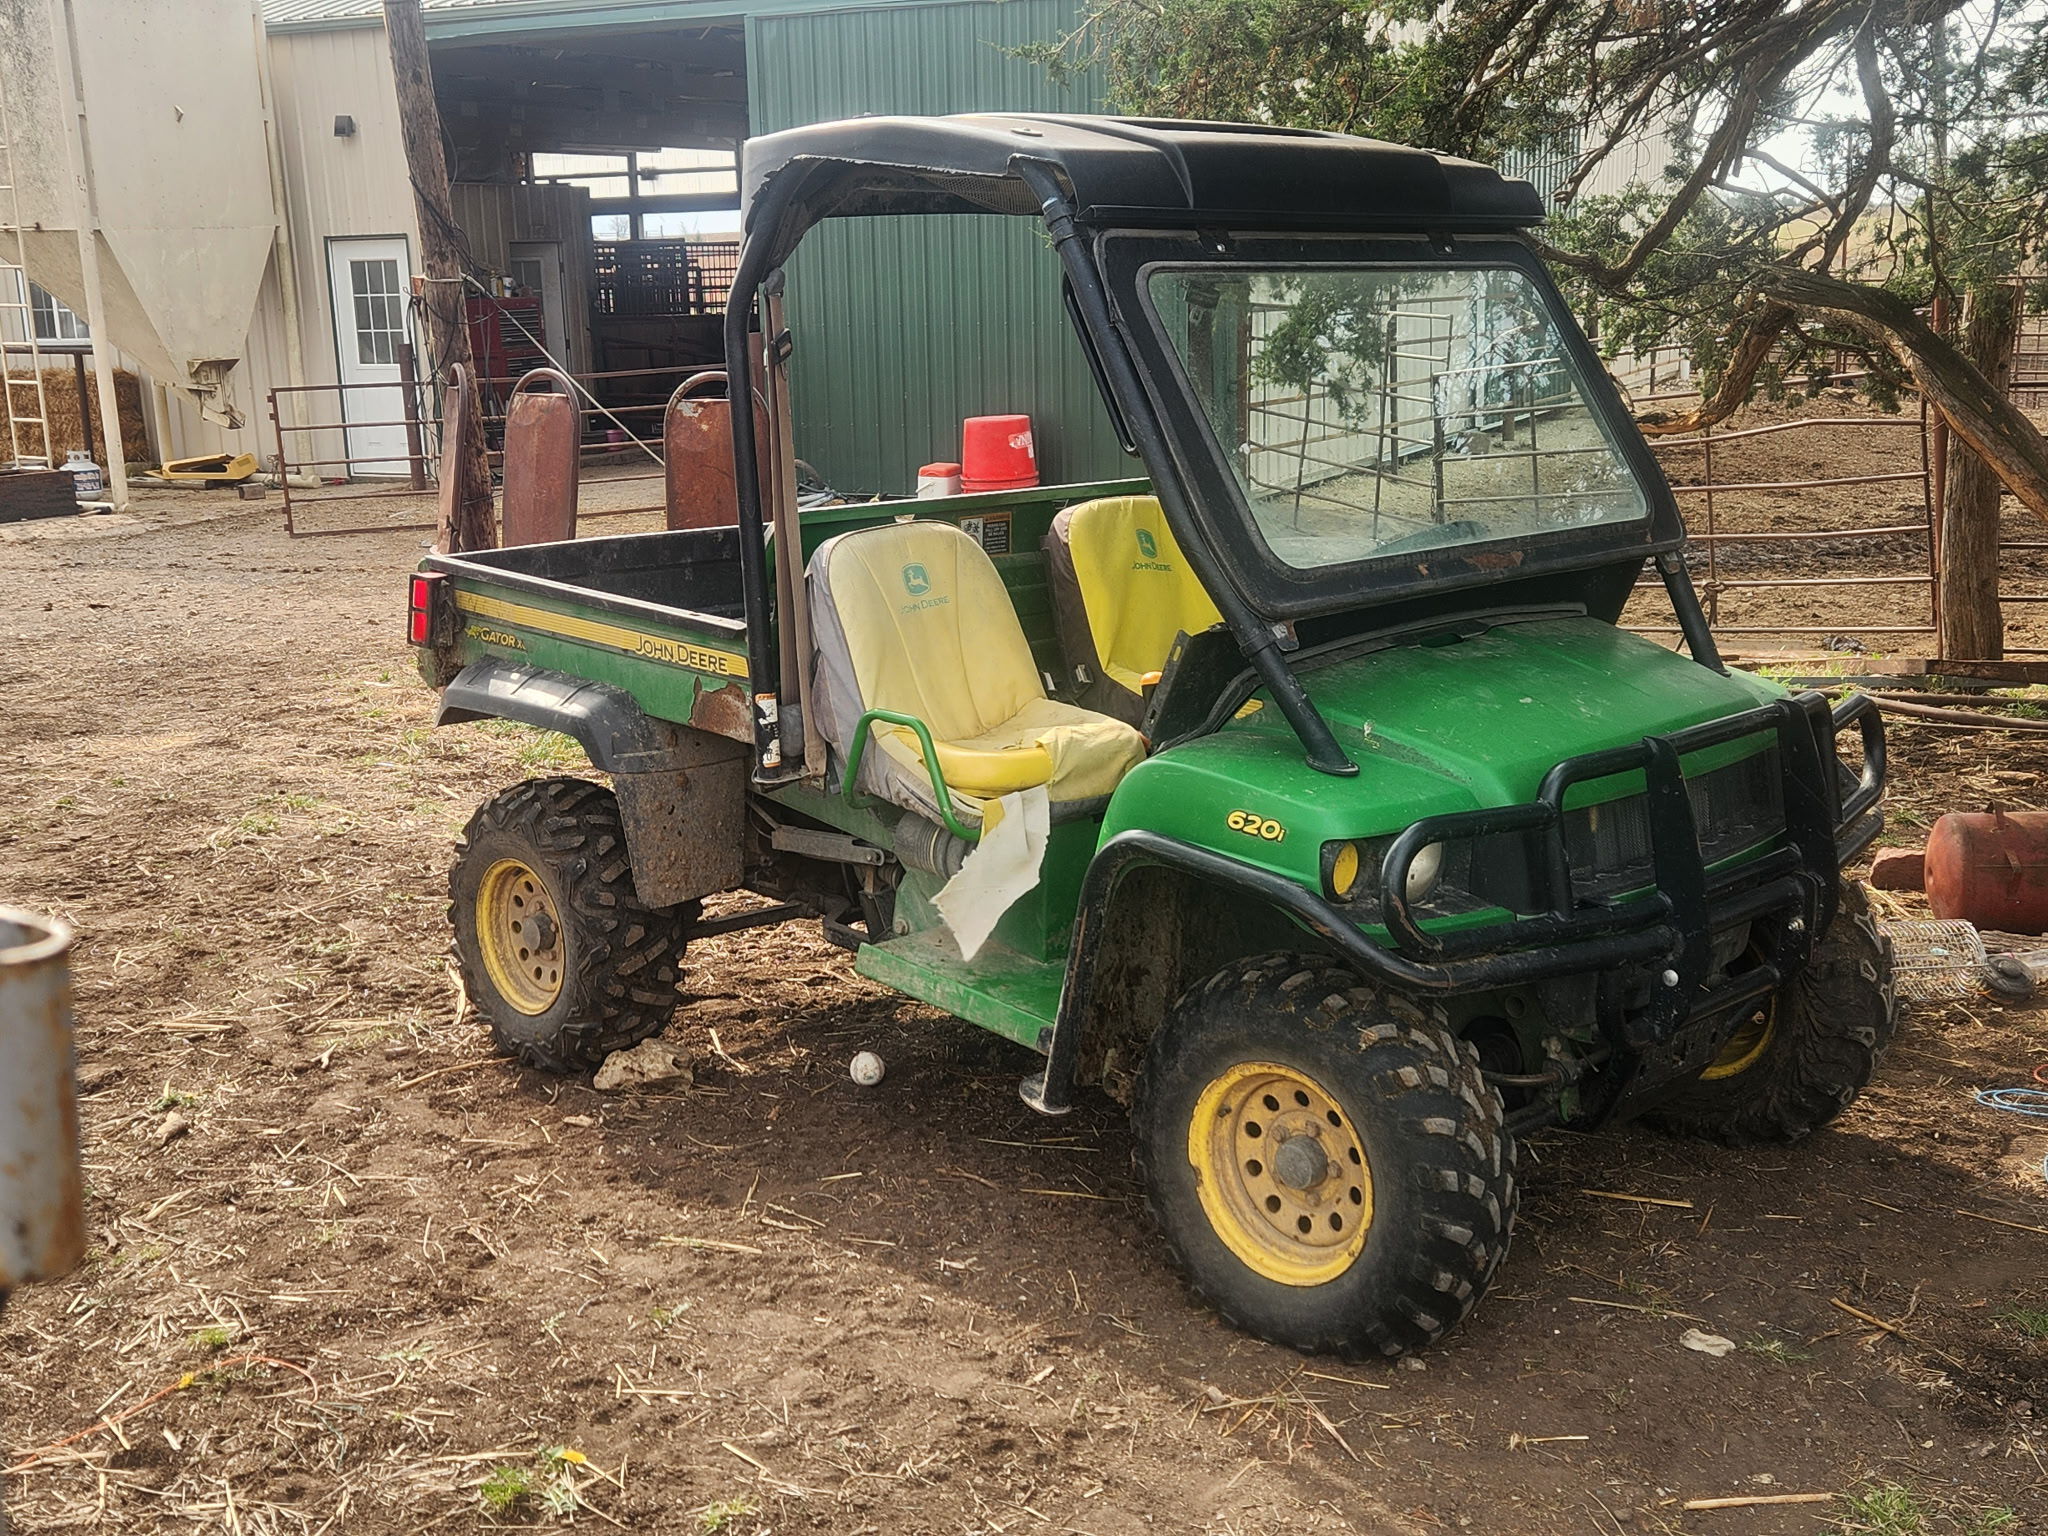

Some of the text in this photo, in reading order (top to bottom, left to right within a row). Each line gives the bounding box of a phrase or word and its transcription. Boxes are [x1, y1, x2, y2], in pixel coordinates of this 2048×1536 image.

[921, 596, 950, 609] DEERE
[480, 626, 516, 648] GATOR
[635, 635, 729, 673] JOHN DEERE
[1227, 809, 1287, 843] 620i
